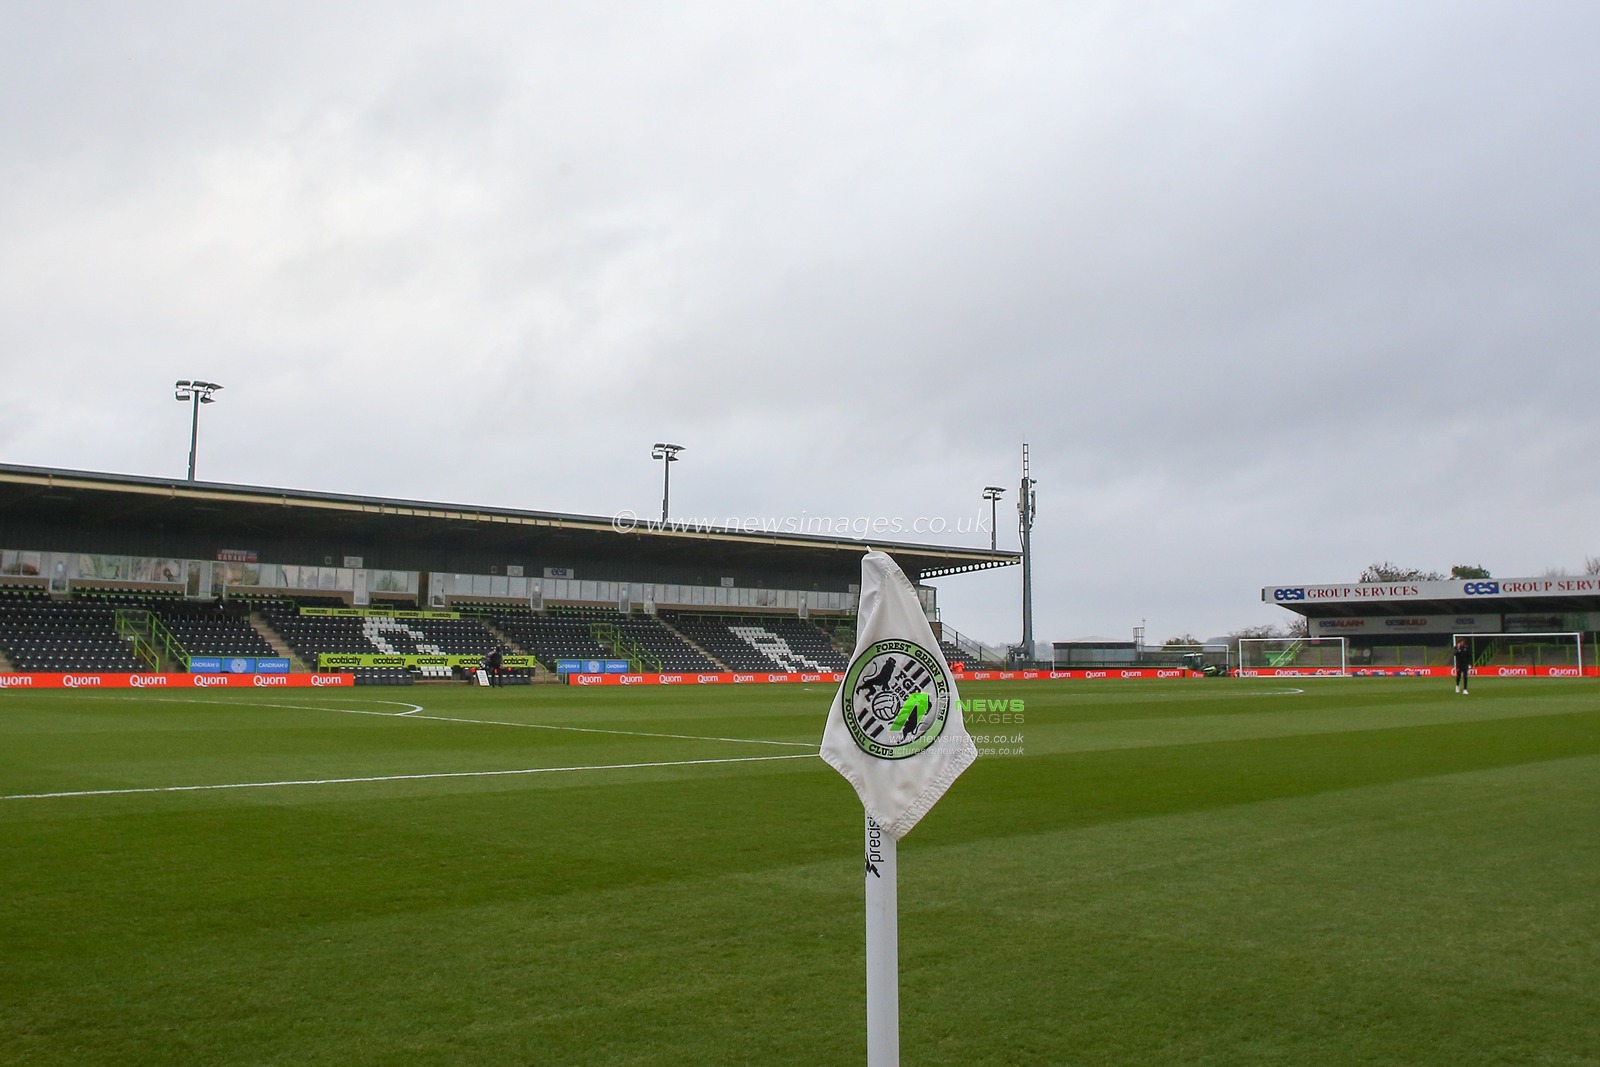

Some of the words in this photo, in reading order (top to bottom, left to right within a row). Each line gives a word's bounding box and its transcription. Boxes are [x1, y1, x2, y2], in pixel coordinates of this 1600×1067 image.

[1308, 589, 1350, 598] GROUP
[1355, 586, 1418, 597] SERVICES
[1502, 581, 1552, 593] GROUP
[327, 657, 361, 666] ecotricity
[373, 657, 406, 666] ecotricity
[417, 657, 449, 666] ecotricity
[503, 657, 529, 666] cotricity
[974, 672, 990, 680] Quorn
[1023, 671, 1038, 679] Quorn
[1050, 671, 1071, 679] Quorn
[1085, 670, 1107, 678] Quorn
[1120, 670, 1142, 678] Quorn
[1157, 669, 1180, 678] Quorn
[1498, 667, 1527, 677] Quorn
[1549, 667, 1578, 677] Quorn
[63, 675, 100, 687] Quorn
[130, 675, 166, 687] Quorn
[193, 674, 228, 687] Quorn
[253, 674, 287, 687] Quorn
[311, 675, 341, 687] Quorn
[577, 675, 602, 685] Quorn
[619, 675, 643, 685] Quorn
[659, 674, 682, 685] Quorn
[697, 674, 719, 684] Quorn
[733, 674, 754, 683] Quorn
[768, 673, 788, 683] Quorn
[801, 673, 821, 682] Quorn
[876, 643, 911, 652] FOREST
[915, 650, 940, 676] GREEN
[937, 680, 946, 721] RORS
[845, 698, 866, 746] FOOTBALL
[869, 744, 893, 756] CLUB
